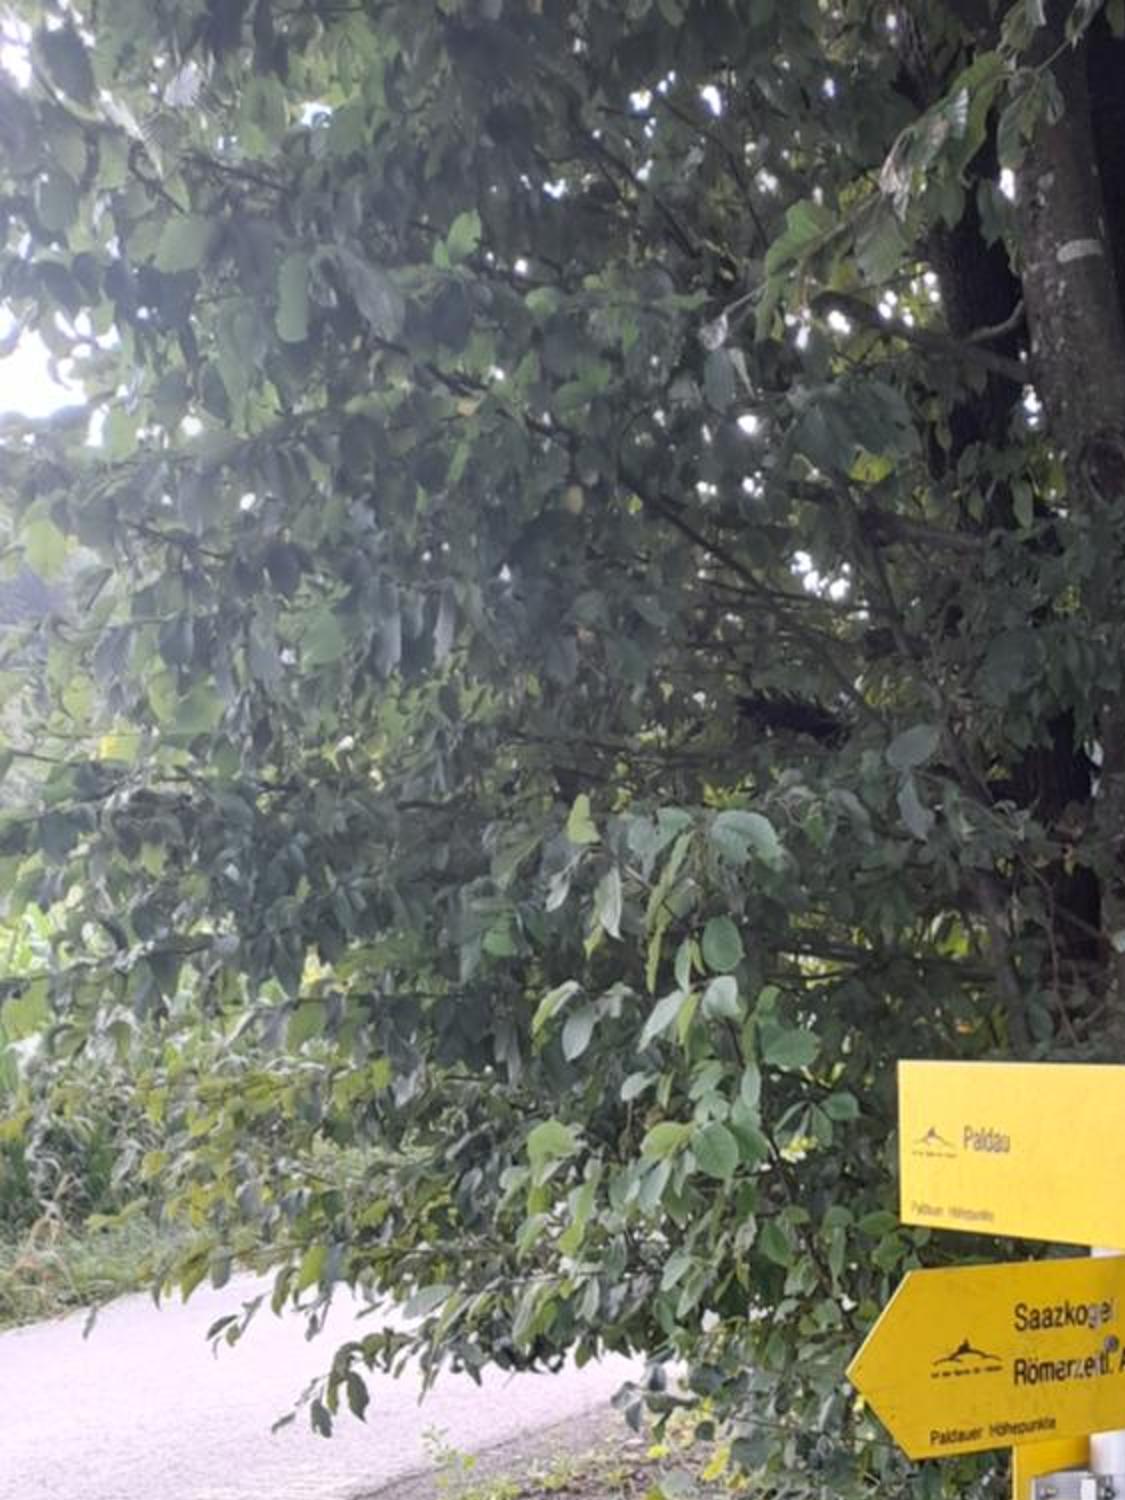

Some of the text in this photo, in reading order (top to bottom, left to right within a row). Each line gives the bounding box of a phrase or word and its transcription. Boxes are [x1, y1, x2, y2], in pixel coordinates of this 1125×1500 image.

[963, 1125, 1011, 1153] Paldau
[930, 1416, 1056, 1447] Paldauer Höhepunkte
